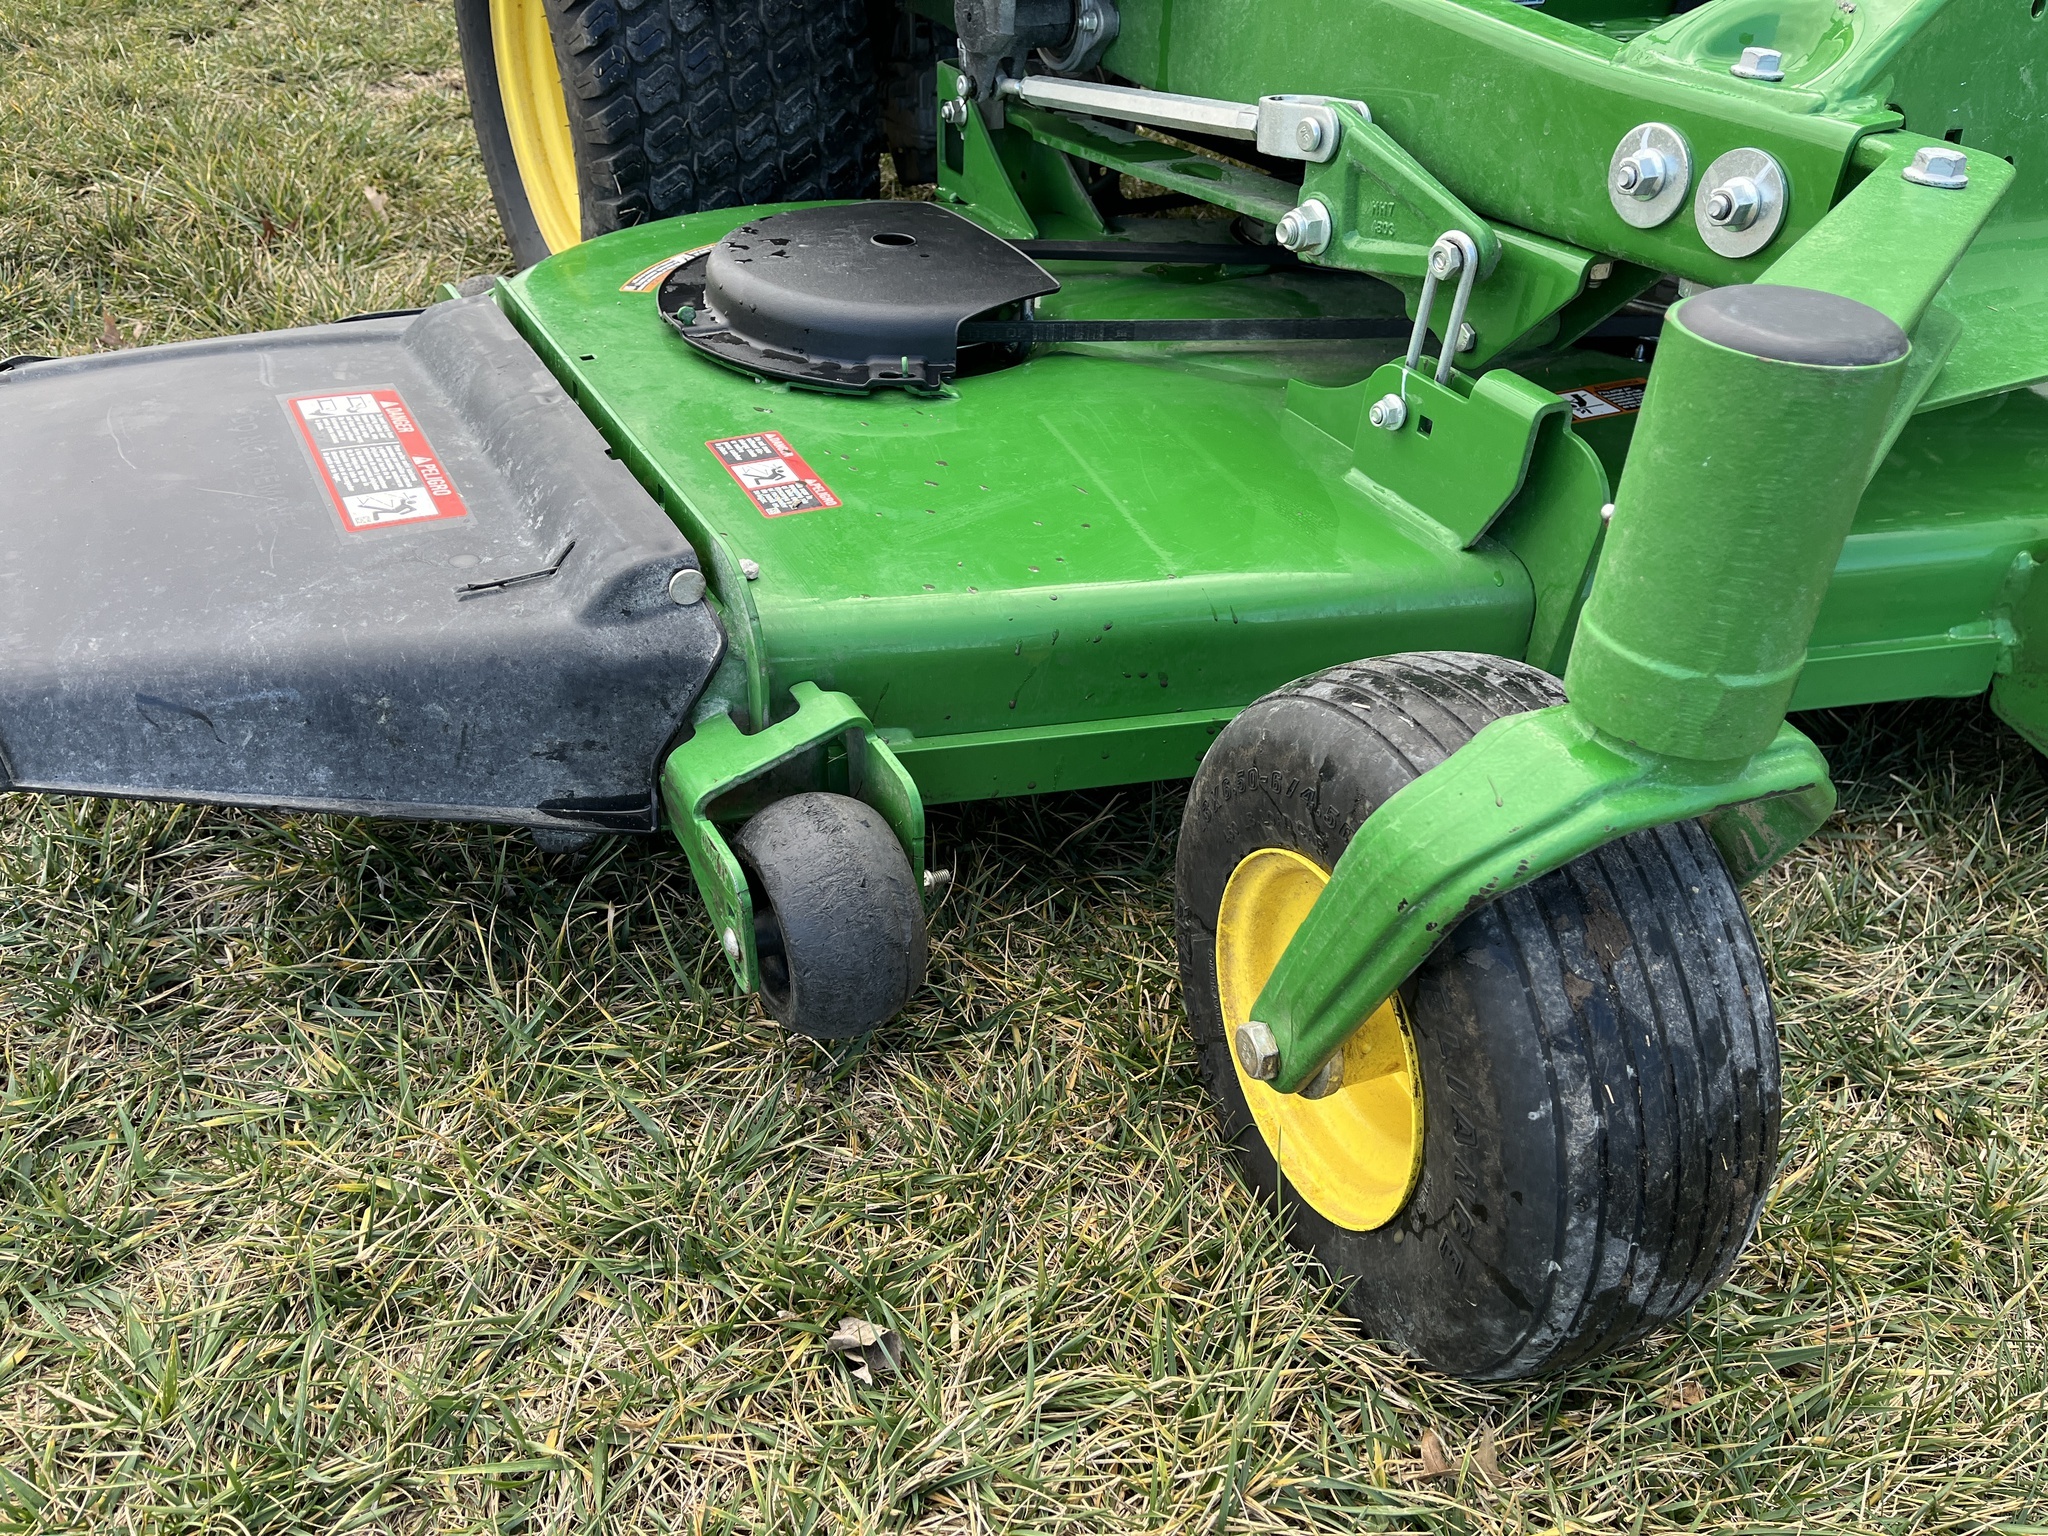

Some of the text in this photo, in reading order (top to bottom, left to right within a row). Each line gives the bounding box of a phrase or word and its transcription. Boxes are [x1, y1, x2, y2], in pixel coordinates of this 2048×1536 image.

[385, 407, 415, 433] DANGER
[418, 463, 452, 496] PELIGRO
[811, 482, 838, 506] PELIGRO
[1418, 978, 1478, 1281] ELIANCE
